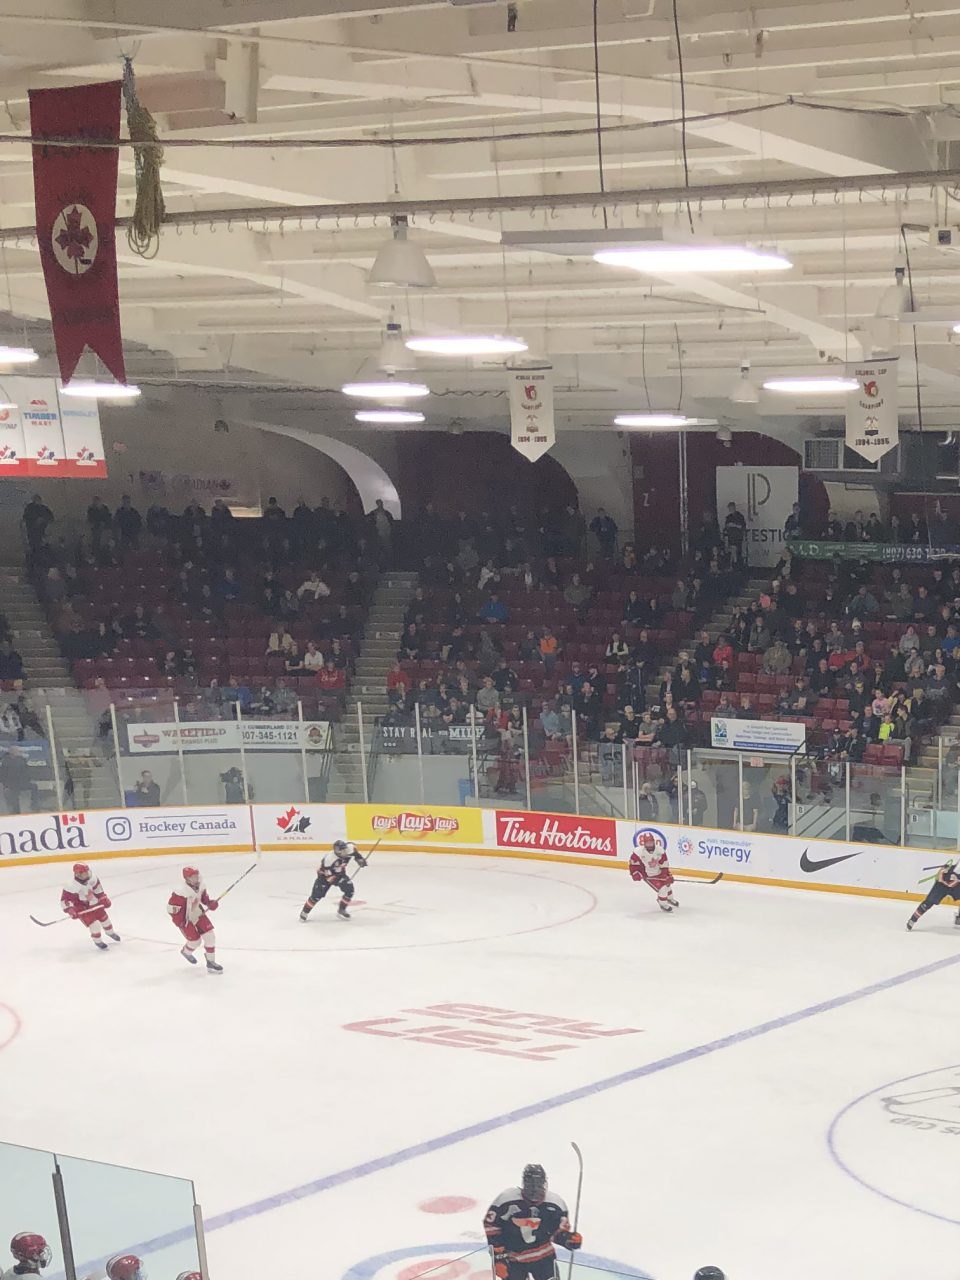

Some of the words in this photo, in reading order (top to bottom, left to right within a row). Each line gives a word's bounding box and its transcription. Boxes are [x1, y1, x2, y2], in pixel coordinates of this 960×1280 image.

[161, 728, 227, 738] WAKEFIELD
[383, 726, 406, 738] STAY
[410, 726, 434, 738] RAL
[139, 820, 186, 835] Hockey
[190, 819, 237, 831] Canada
[399, 813, 433, 831] Lay's
[500, 817, 536, 843] Tim
[539, 818, 613, 852] Hortons
[698, 840, 752, 863] Synergy
[890, 1116, 937, 1132] Cup
